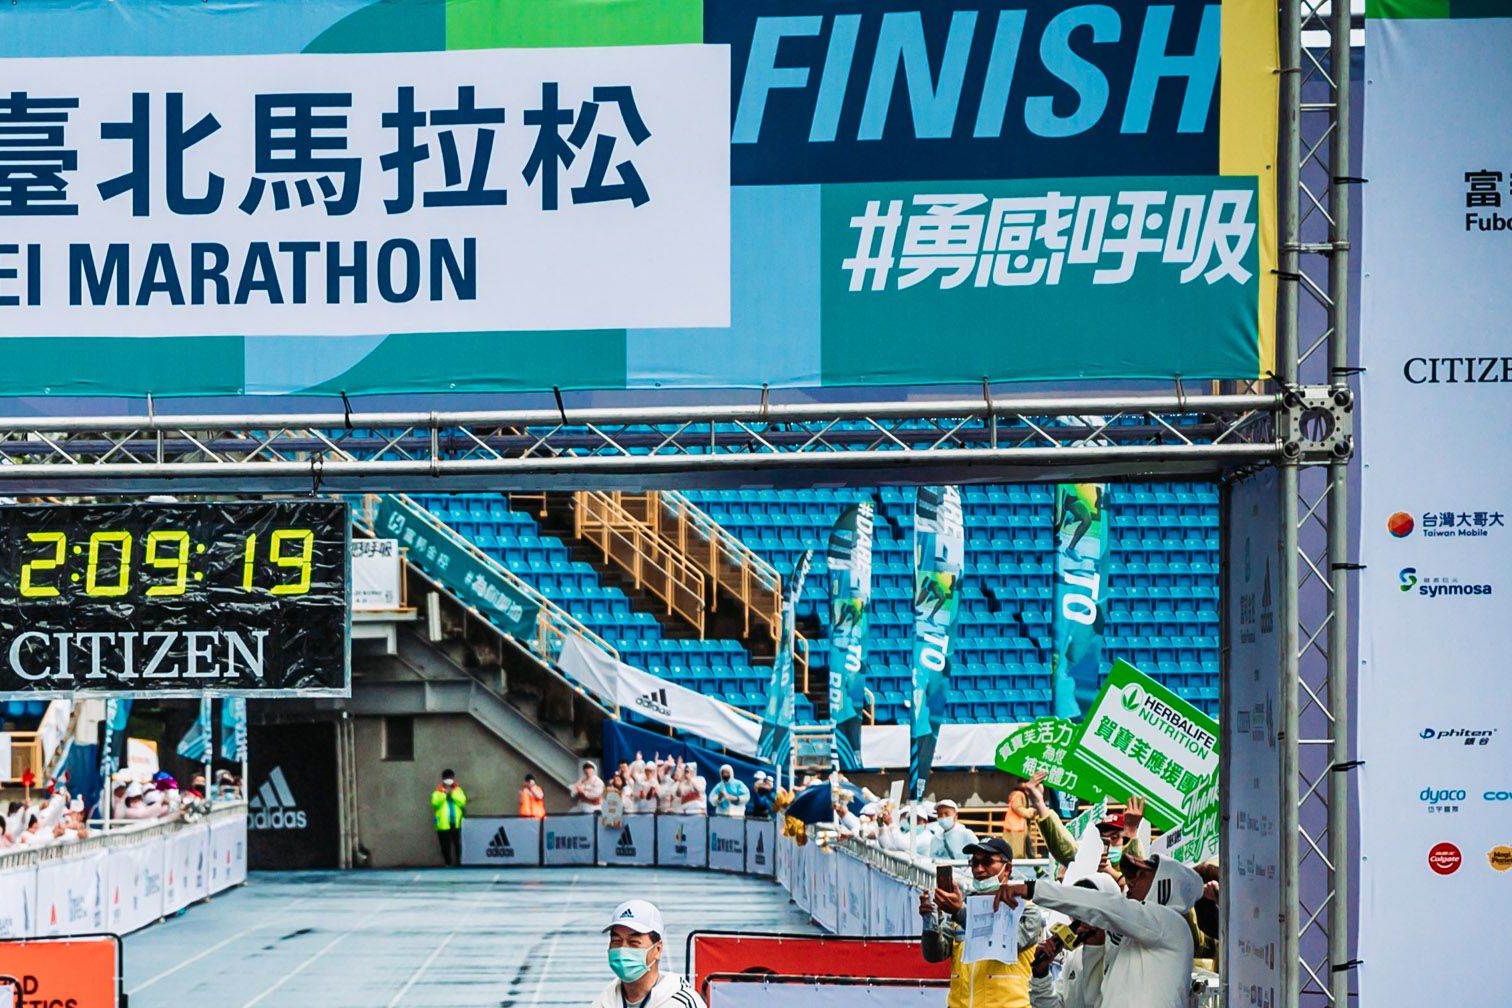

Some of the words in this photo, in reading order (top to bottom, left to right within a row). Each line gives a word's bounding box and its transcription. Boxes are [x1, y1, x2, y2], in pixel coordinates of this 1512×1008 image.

[730, 2, 1223, 144] FINISH
[1464, 169, 1512, 208] 富
[841, 188, 1257, 293] #勇感呼吸
[67, 237, 479, 306] MARATHON
[1422, 511, 1505, 528] 台灣大哥大
[1422, 528, 1456, 537] Taiwan
[1458, 528, 1488, 537] Mobile
[20, 528, 315, 599] 2:09:19
[1062, 572, 1101, 626] TO
[1418, 584, 1492, 598] synmosa
[9, 630, 270, 681] CITIZEN
[1138, 709, 1209, 761] NUTRITION
[1143, 695, 1216, 750] HERBALIFE
[1437, 728, 1493, 739] phiten
[1419, 786, 1467, 804] dyaco
